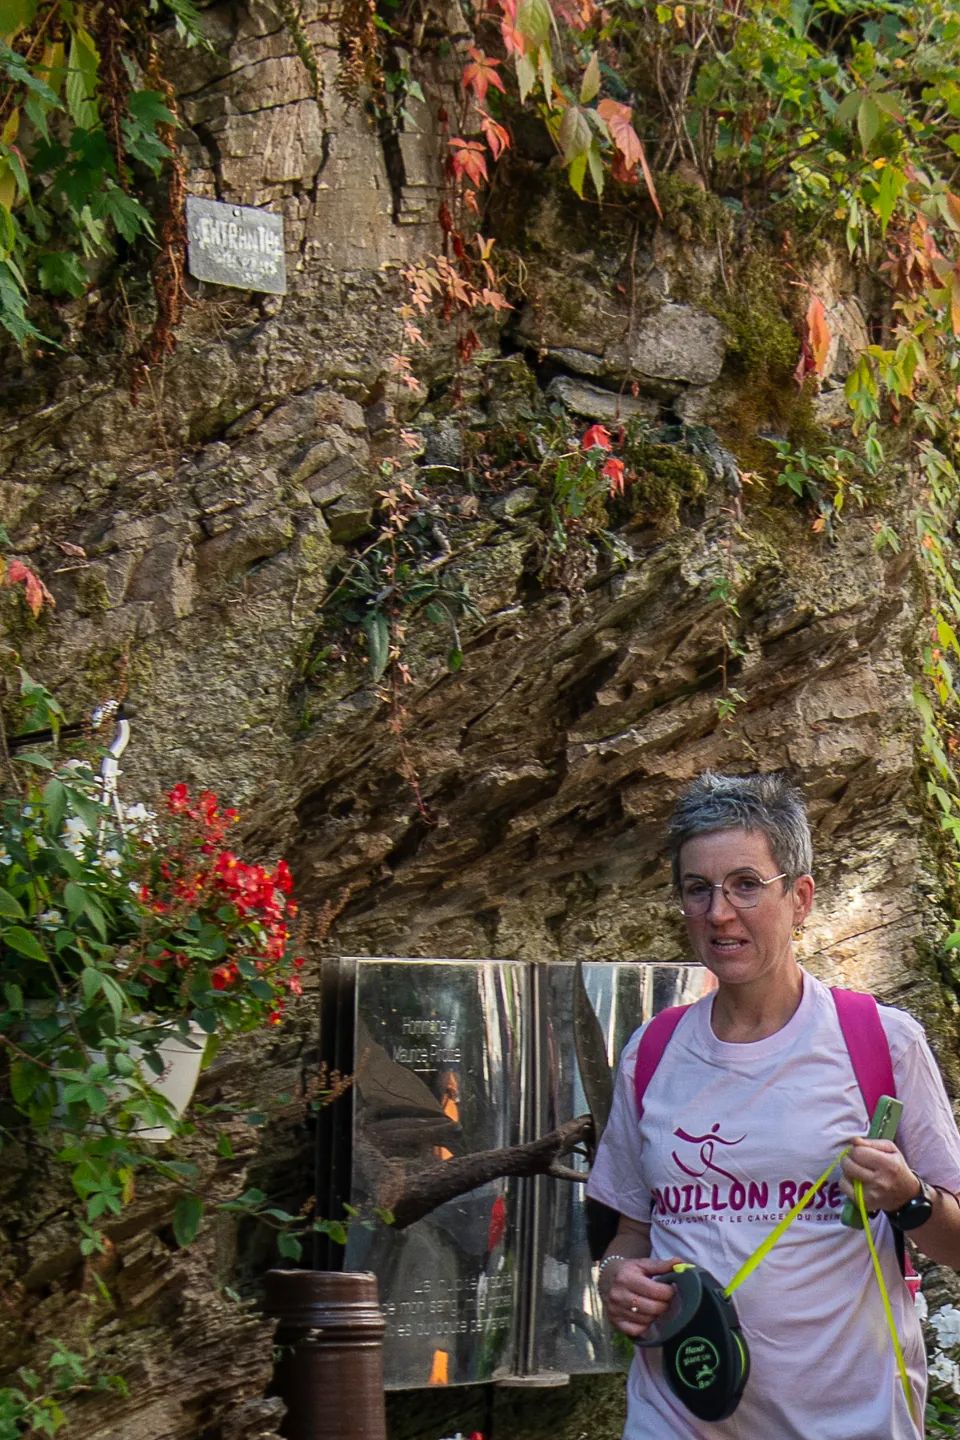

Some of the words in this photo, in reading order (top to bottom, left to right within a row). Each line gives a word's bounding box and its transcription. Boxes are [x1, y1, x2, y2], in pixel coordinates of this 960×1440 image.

[779, 1180, 841, 1209] ROSE
[686, 1214, 724, 1224] CONTRE
[730, 1214, 743, 1223] LE
[797, 1213, 811, 1221] DU
